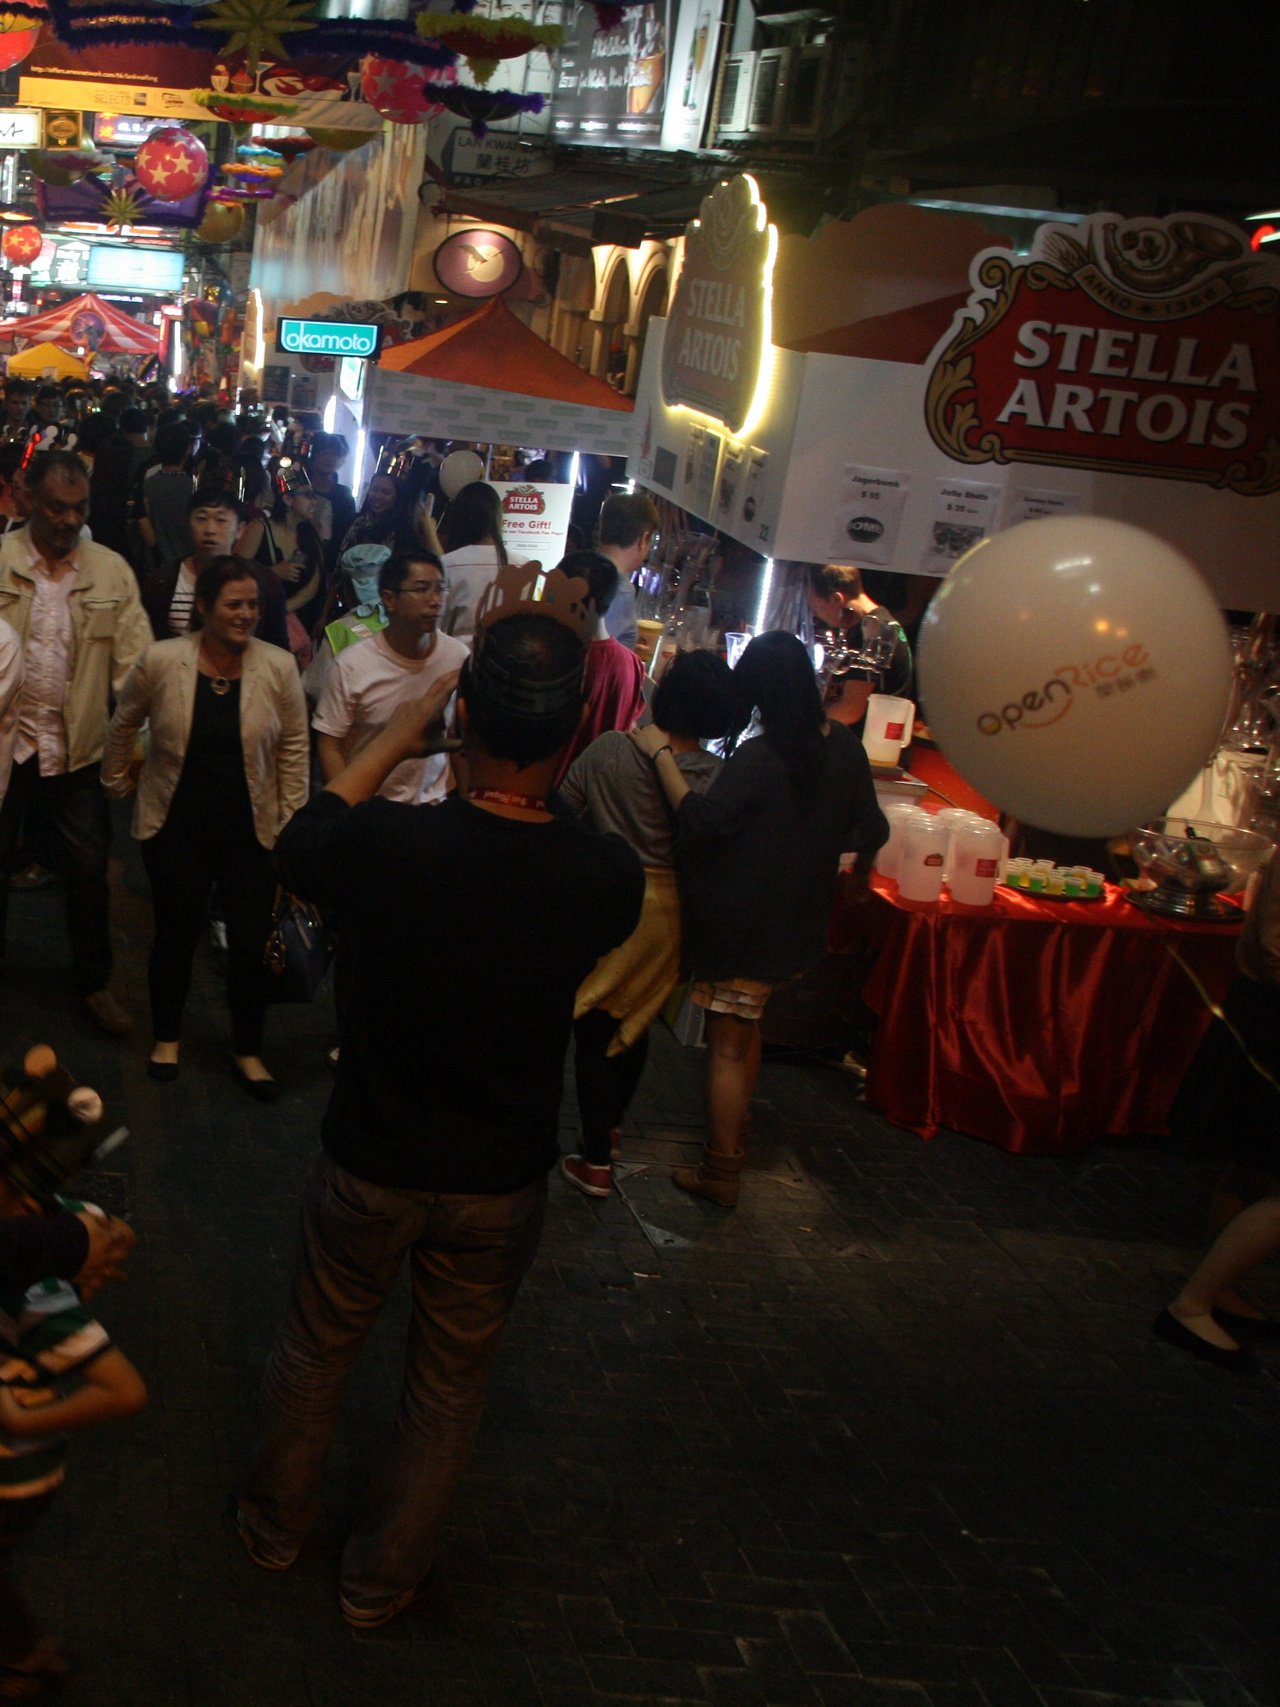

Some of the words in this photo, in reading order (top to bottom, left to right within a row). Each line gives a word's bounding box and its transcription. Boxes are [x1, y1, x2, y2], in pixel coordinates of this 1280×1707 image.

[686, 277, 745, 329] STELLA
[1084, 273, 1132, 310] ANNO
[1163, 288, 1218, 314] 1366
[286, 322, 371, 352] okamoto
[678, 326, 742, 382] ARTOIS
[1012, 319, 1259, 393] STELLA
[995, 378, 1252, 450] ARTOIS
[508, 503, 539, 511] ARTOIS
[509, 496, 539, 504] STELLA
[502, 519, 525, 529] Free
[528, 520, 552, 530] Gift!
